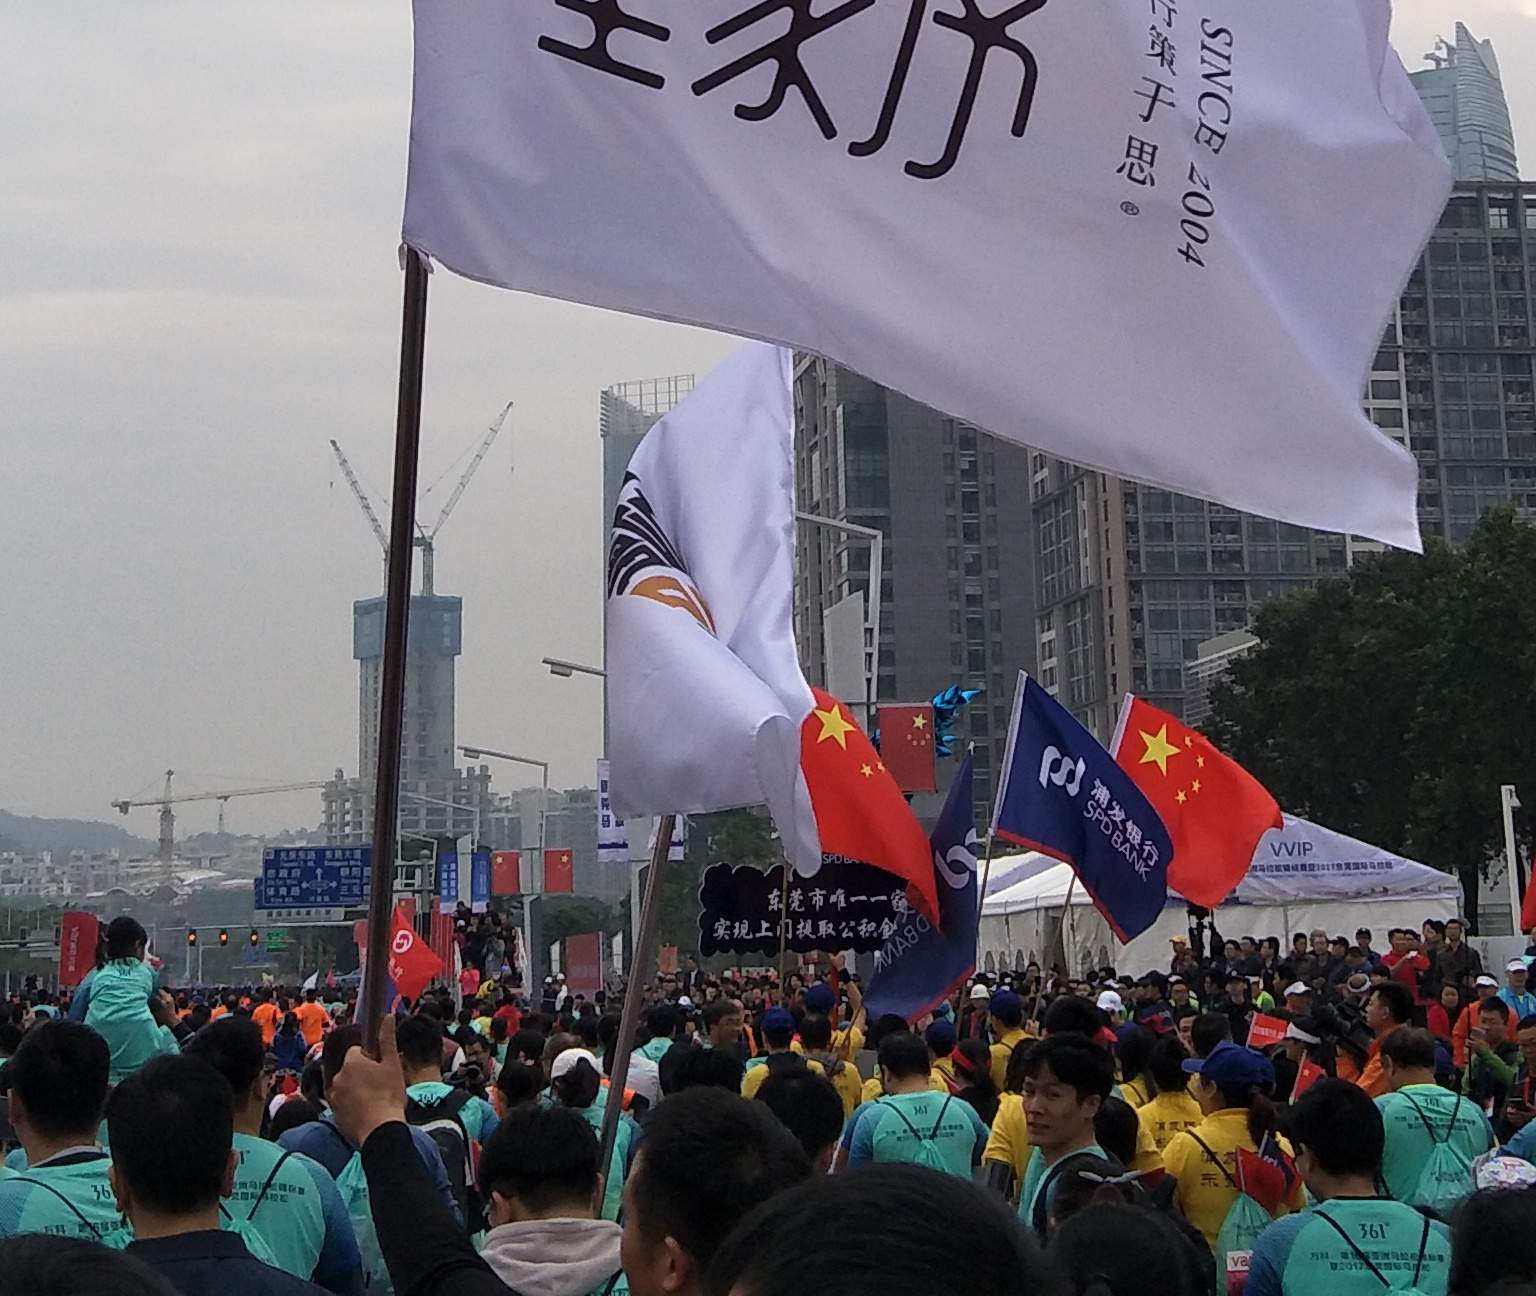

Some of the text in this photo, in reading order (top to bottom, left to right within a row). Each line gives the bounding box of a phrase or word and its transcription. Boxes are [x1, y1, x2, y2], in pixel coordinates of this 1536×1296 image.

[1176, 17, 1234, 268] SINCE 2004
[1083, 800, 1152, 882] SPD BANK
[1090, 777, 1160, 867] 浦发银行
[1270, 841, 1313, 857] VVIP
